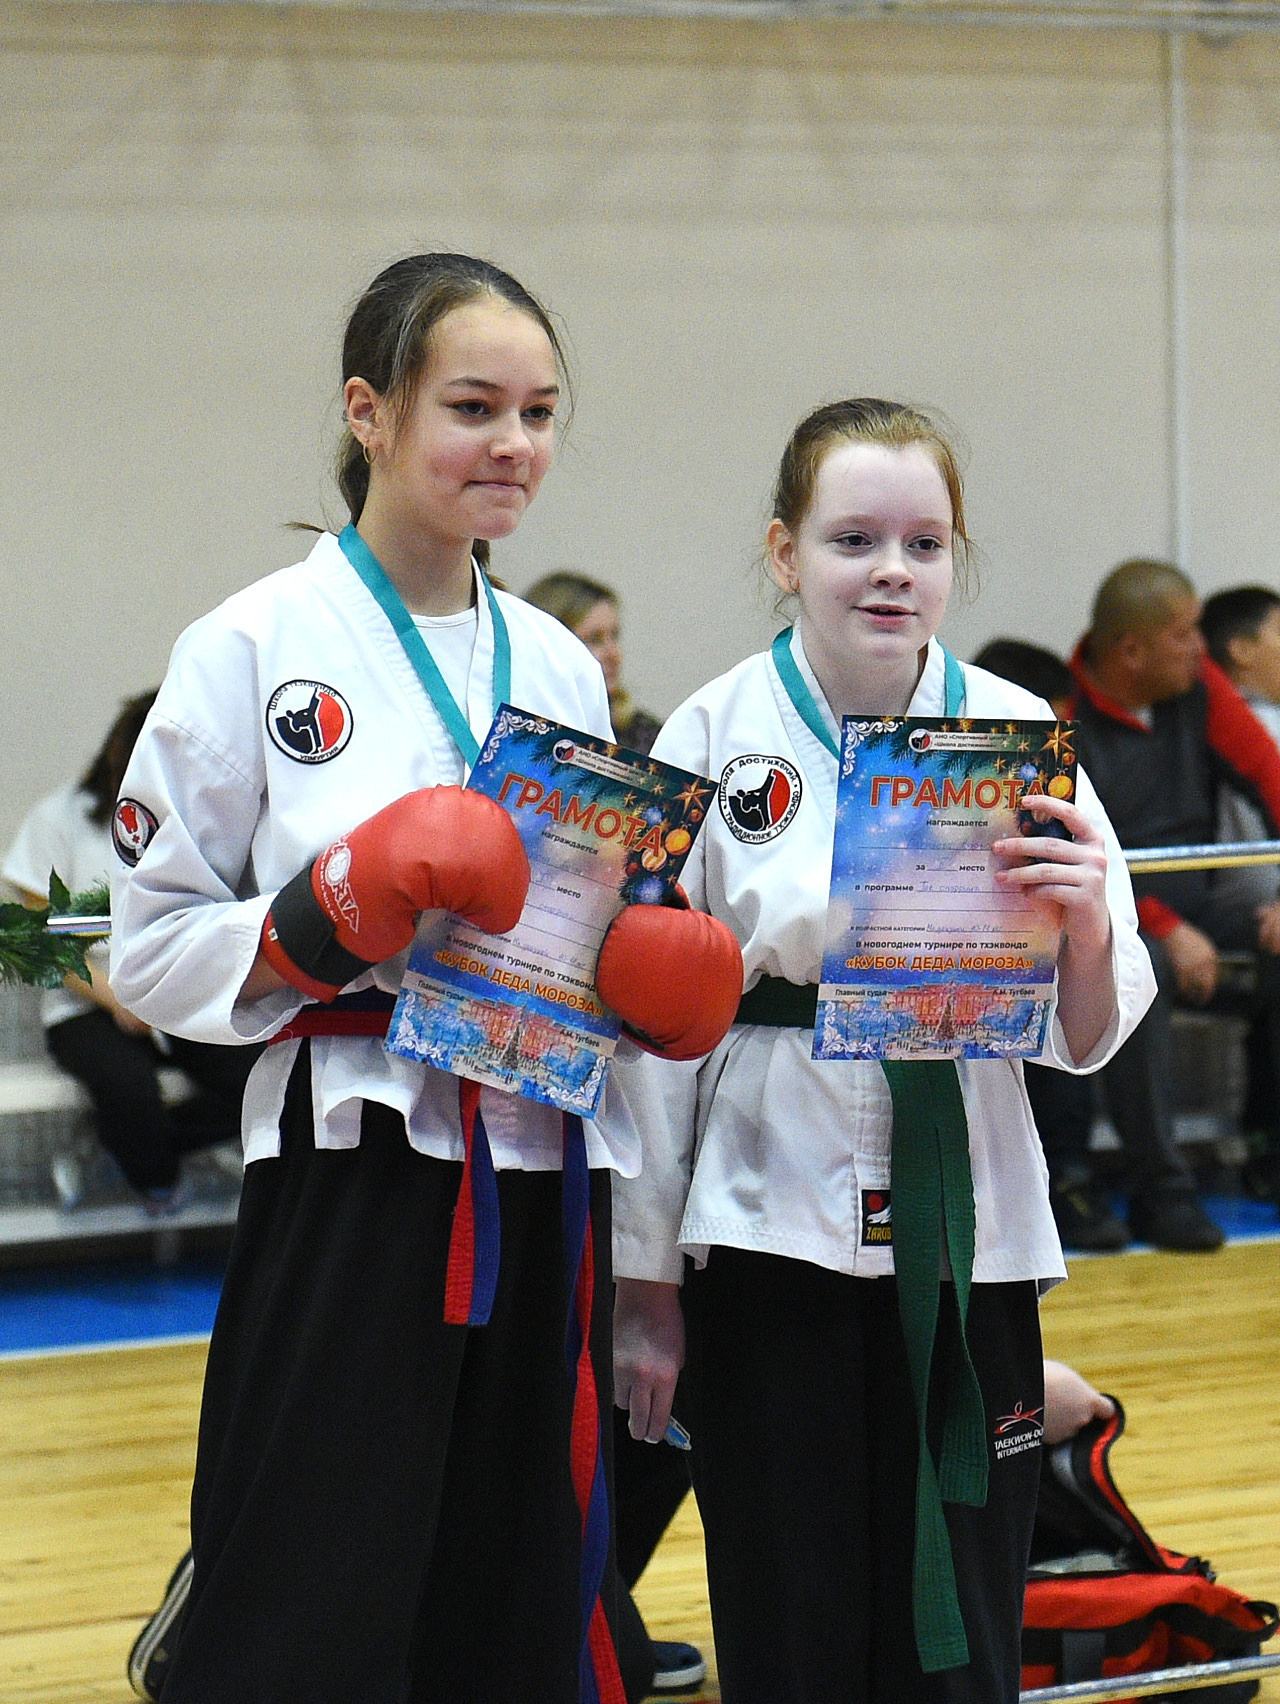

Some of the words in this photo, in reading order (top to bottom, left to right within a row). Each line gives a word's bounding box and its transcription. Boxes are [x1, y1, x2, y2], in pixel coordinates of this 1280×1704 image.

[497, 772, 665, 858] ГРАМОТА
[926, 818, 989, 828] награждается
[541, 831, 599, 855] награждается
[959, 864, 986, 872] место
[556, 886, 582, 899] место
[863, 941, 922, 949] новогоднем
[924, 942, 964, 950] турнире
[979, 942, 1028, 950] тхэквондо
[452, 938, 505, 960] новогоднем
[506, 955, 542, 974] турнире
[543, 968, 555, 978] по
[557, 973, 596, 993] тхэквонд
[845, 956, 907, 970] «КУБОК
[911, 956, 955, 971] ДЕДА
[959, 956, 1034, 970] МОРОЗА»
[434, 950, 489, 978] «КУБОК
[490, 967, 531, 993] ДЕДА
[534, 982, 605, 1017] МОРОЗА»
